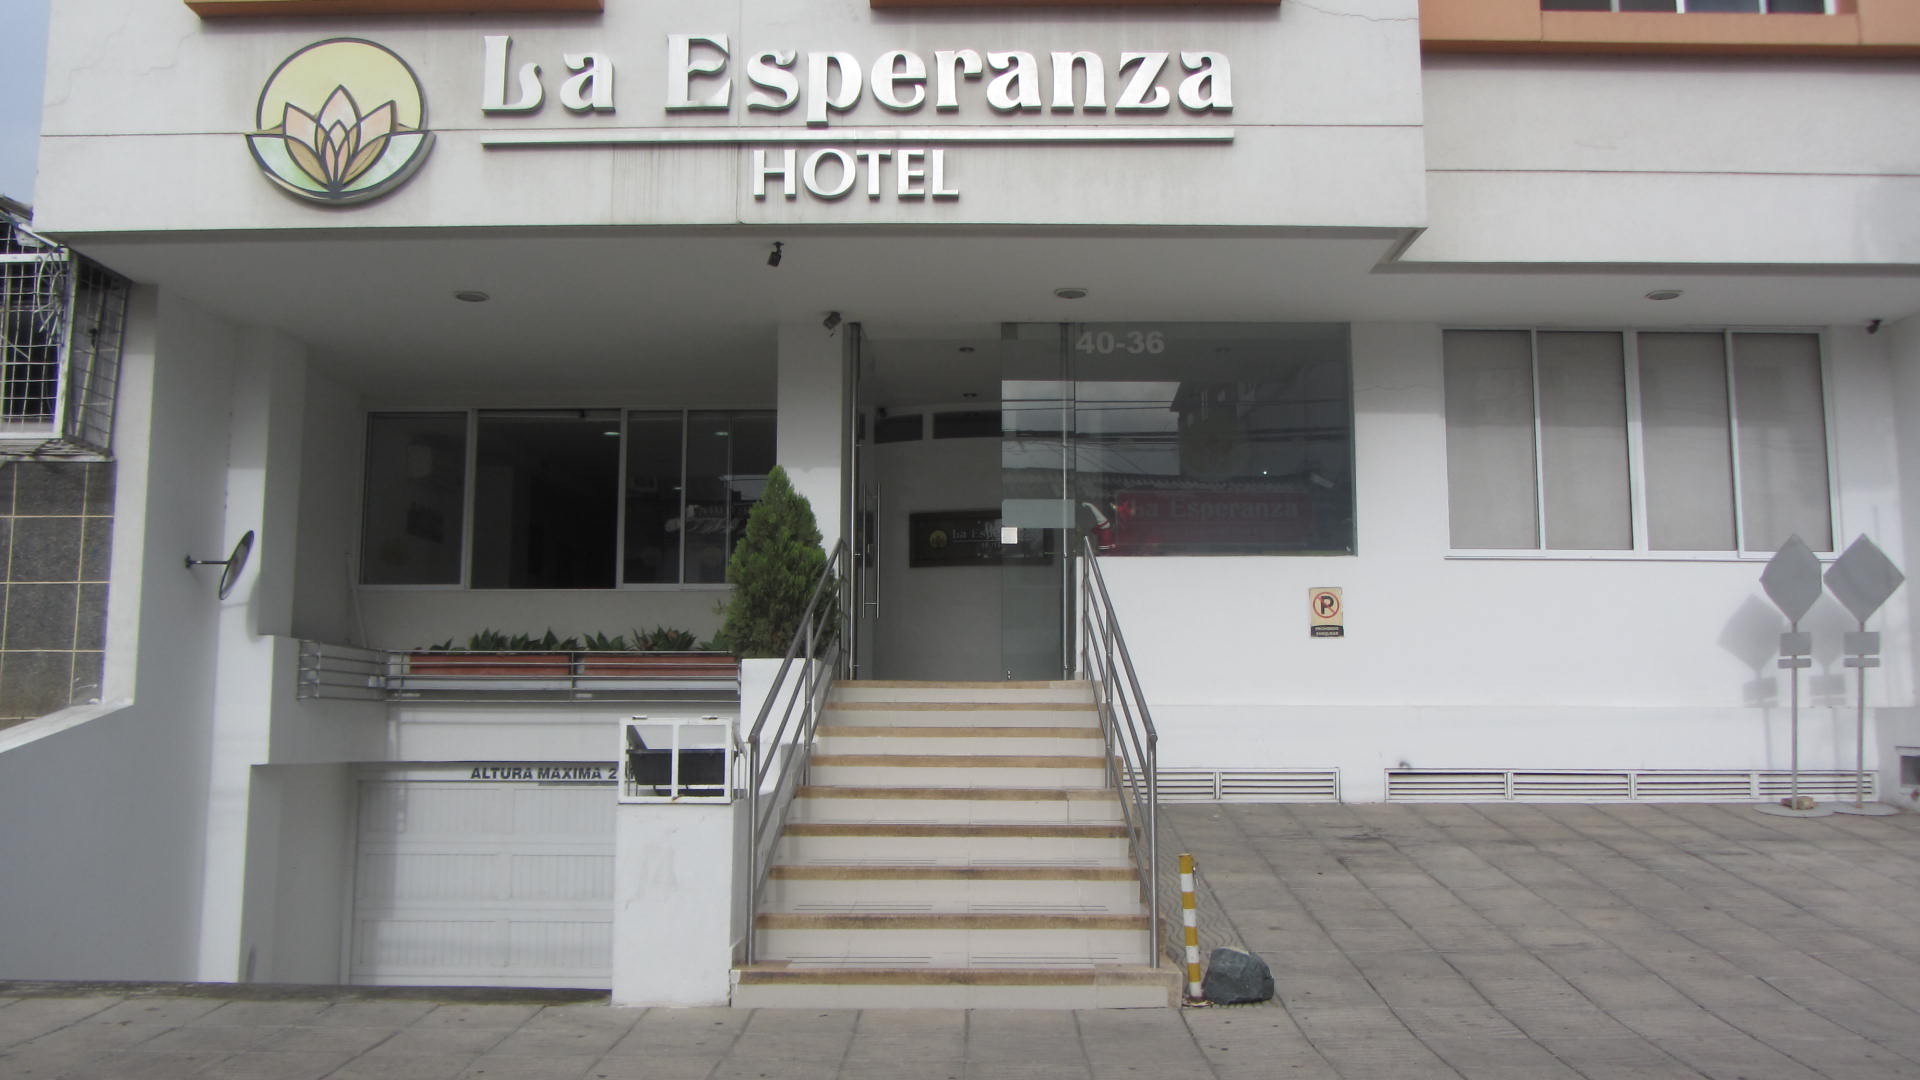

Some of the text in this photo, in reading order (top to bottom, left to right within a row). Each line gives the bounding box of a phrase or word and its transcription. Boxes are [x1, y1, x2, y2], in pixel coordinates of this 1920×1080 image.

[481, 33, 1234, 127] La Esperanza
[753, 148, 960, 199] HOTEL
[1075, 331, 1165, 354] 40-36
[1171, 498, 1298, 522] Esperanza
[471, 767, 533, 780] ALTURA
[537, 767, 601, 780] MAXIMA
